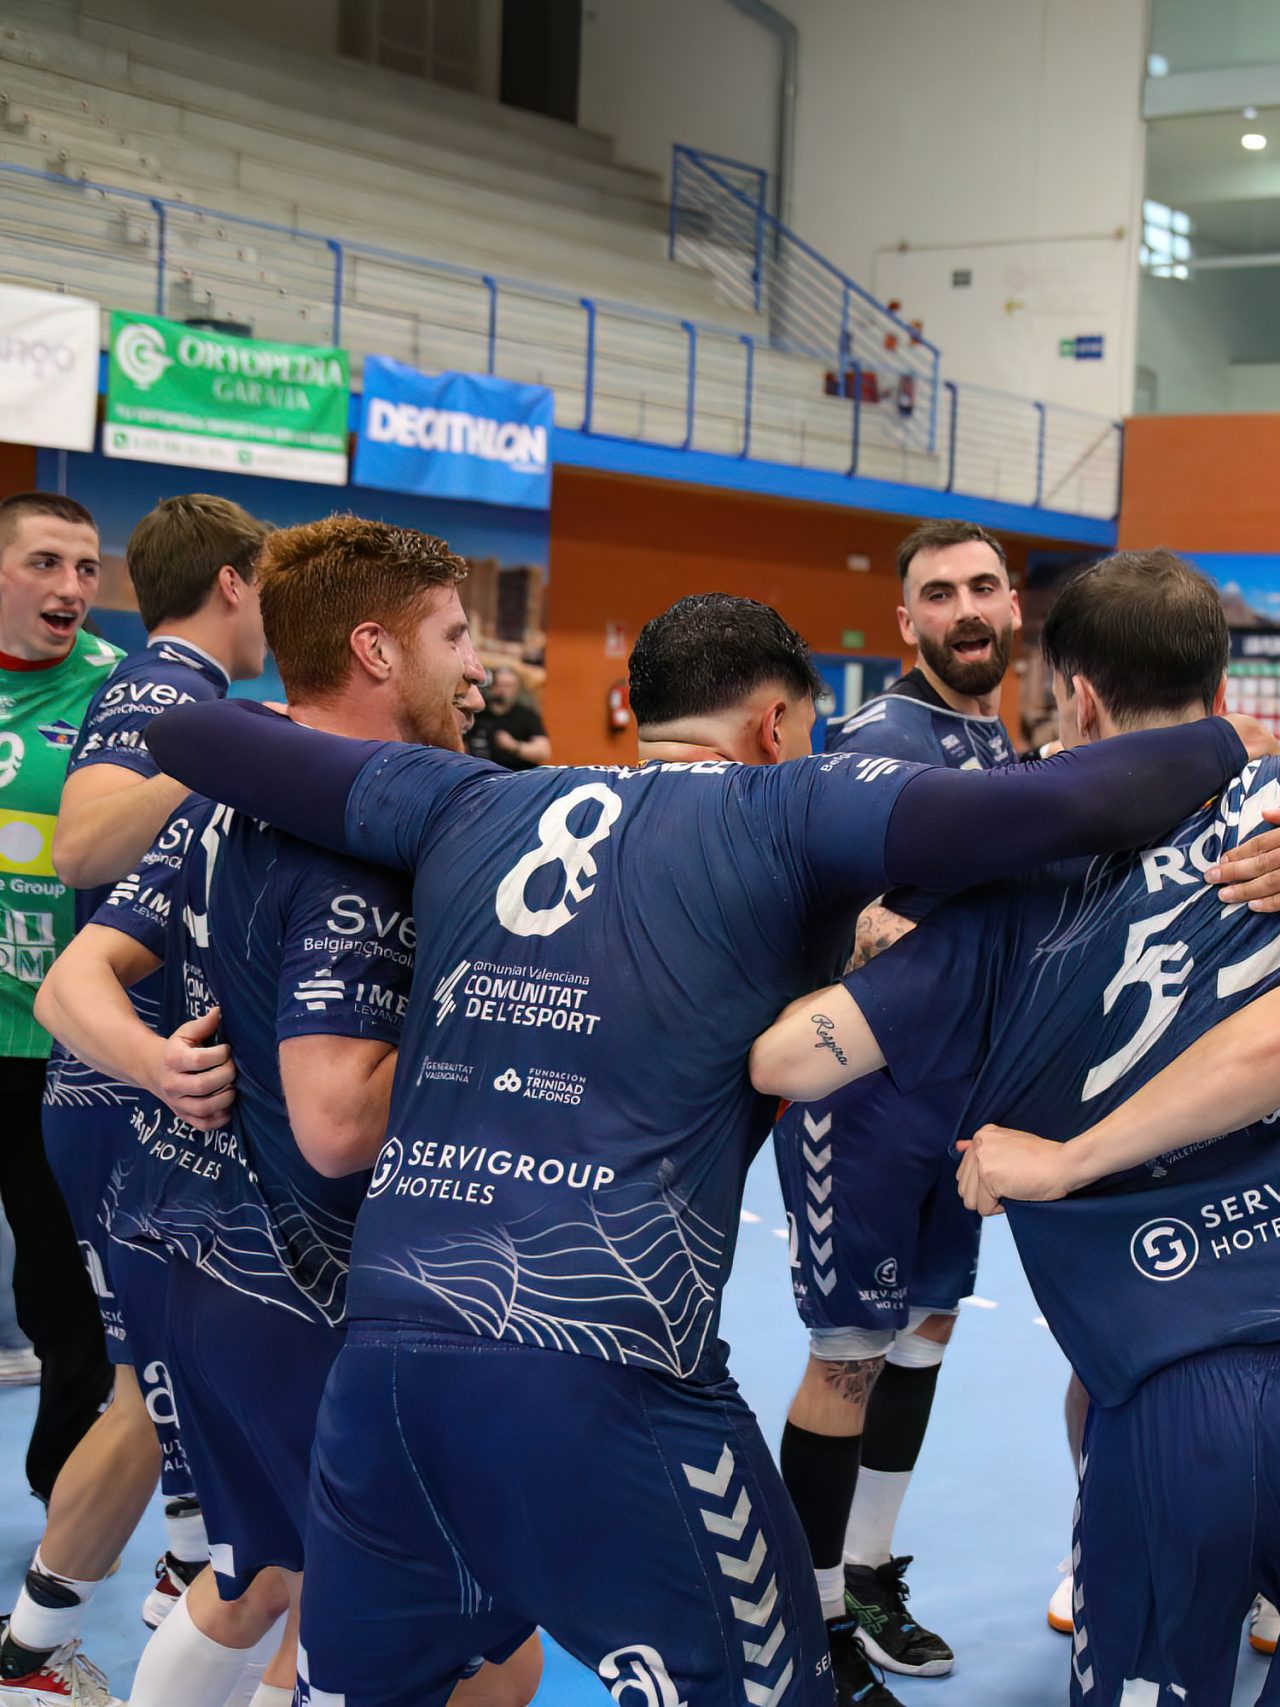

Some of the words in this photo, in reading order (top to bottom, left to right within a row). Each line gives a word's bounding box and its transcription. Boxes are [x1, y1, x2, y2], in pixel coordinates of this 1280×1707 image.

[178, 336, 343, 388] ORTOPEDIA
[368, 398, 546, 464] DECATHLON
[496, 783, 622, 937] 8
[10, 878, 66, 899] Group
[138, 887, 171, 917] IM
[326, 894, 417, 949] Sve
[464, 974, 588, 1009] COMUNITAT
[529, 966, 589, 986] Valenciana
[354, 1002, 404, 1025] LEVANT
[355, 983, 409, 1017] IME
[811, 1013, 848, 1066] Respira
[523, 1087, 581, 1105] ALFONSO
[526, 1076, 584, 1095] TRINIDAD
[149, 1140, 222, 1181] HOELES
[408, 1141, 615, 1191] SERVIGROUP
[395, 1176, 495, 1205] HOTELES
